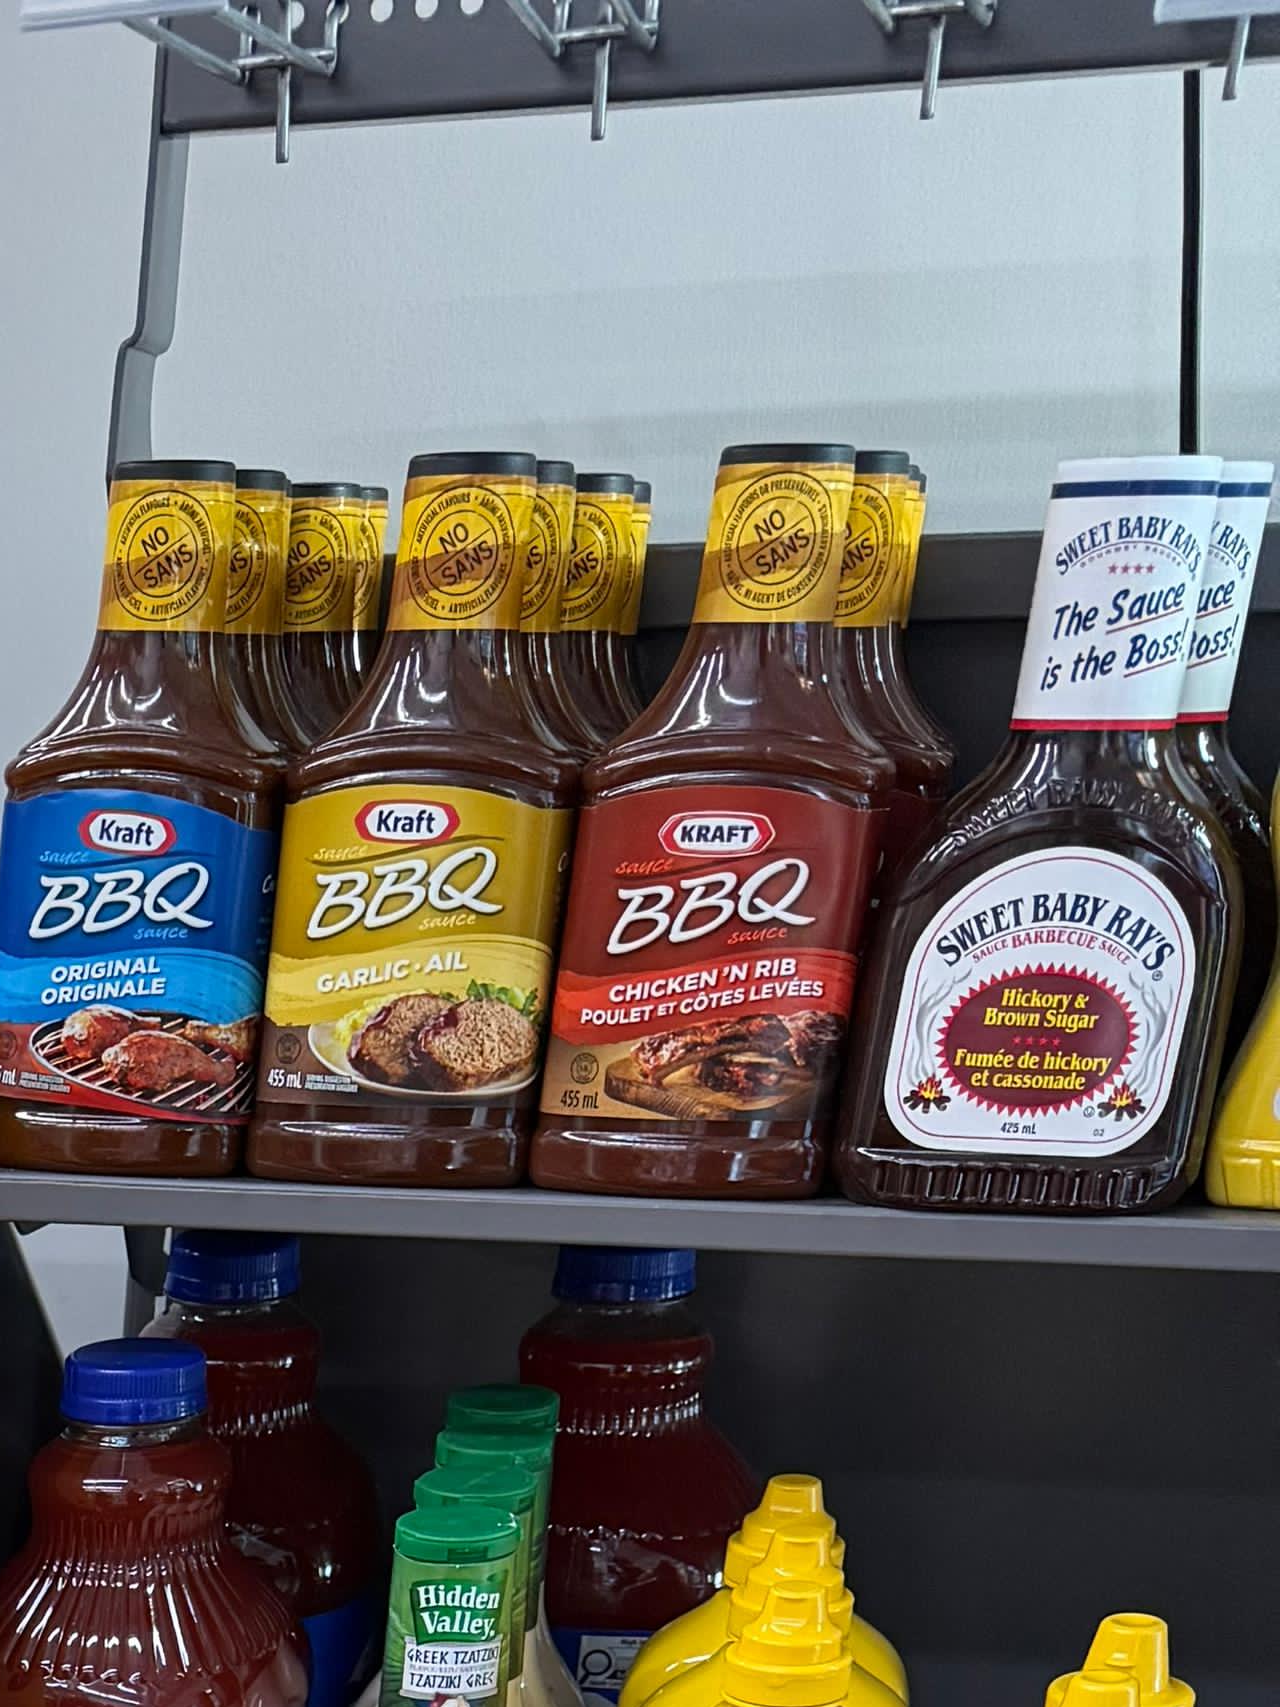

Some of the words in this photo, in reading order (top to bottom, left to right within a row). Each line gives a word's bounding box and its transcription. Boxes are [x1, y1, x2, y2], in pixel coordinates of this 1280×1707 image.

[140, 525, 171, 556] NO
[142, 543, 194, 589] SANS
[98, 820, 154, 847] Kraft
[679, 823, 755, 844] KRAFT
[28, 862, 215, 940] BBQ
[606, 858, 816, 955] BBQ
[937, 900, 1025, 968] SWEET
[1031, 892, 1104, 925] BABY
[1103, 903, 1175, 972] RAY'S
[50, 956, 162, 985] ORIGINAL
[317, 959, 411, 994] GARLIC
[421, 952, 469, 974] AIL
[609, 968, 718, 1004] CHICKEN
[755, 958, 797, 979] RIB
[580, 1003, 654, 1026] POULET
[656, 1001, 677, 1017] ET
[679, 988, 745, 1014] CÔTES
[748, 975, 824, 1002] LEVÉES
[983, 1008, 1041, 1028] Brown
[1043, 1011, 1100, 1034] Sugar
[1001, 988, 1072, 1012] Hickory
[1074, 993, 1089, 1009] &
